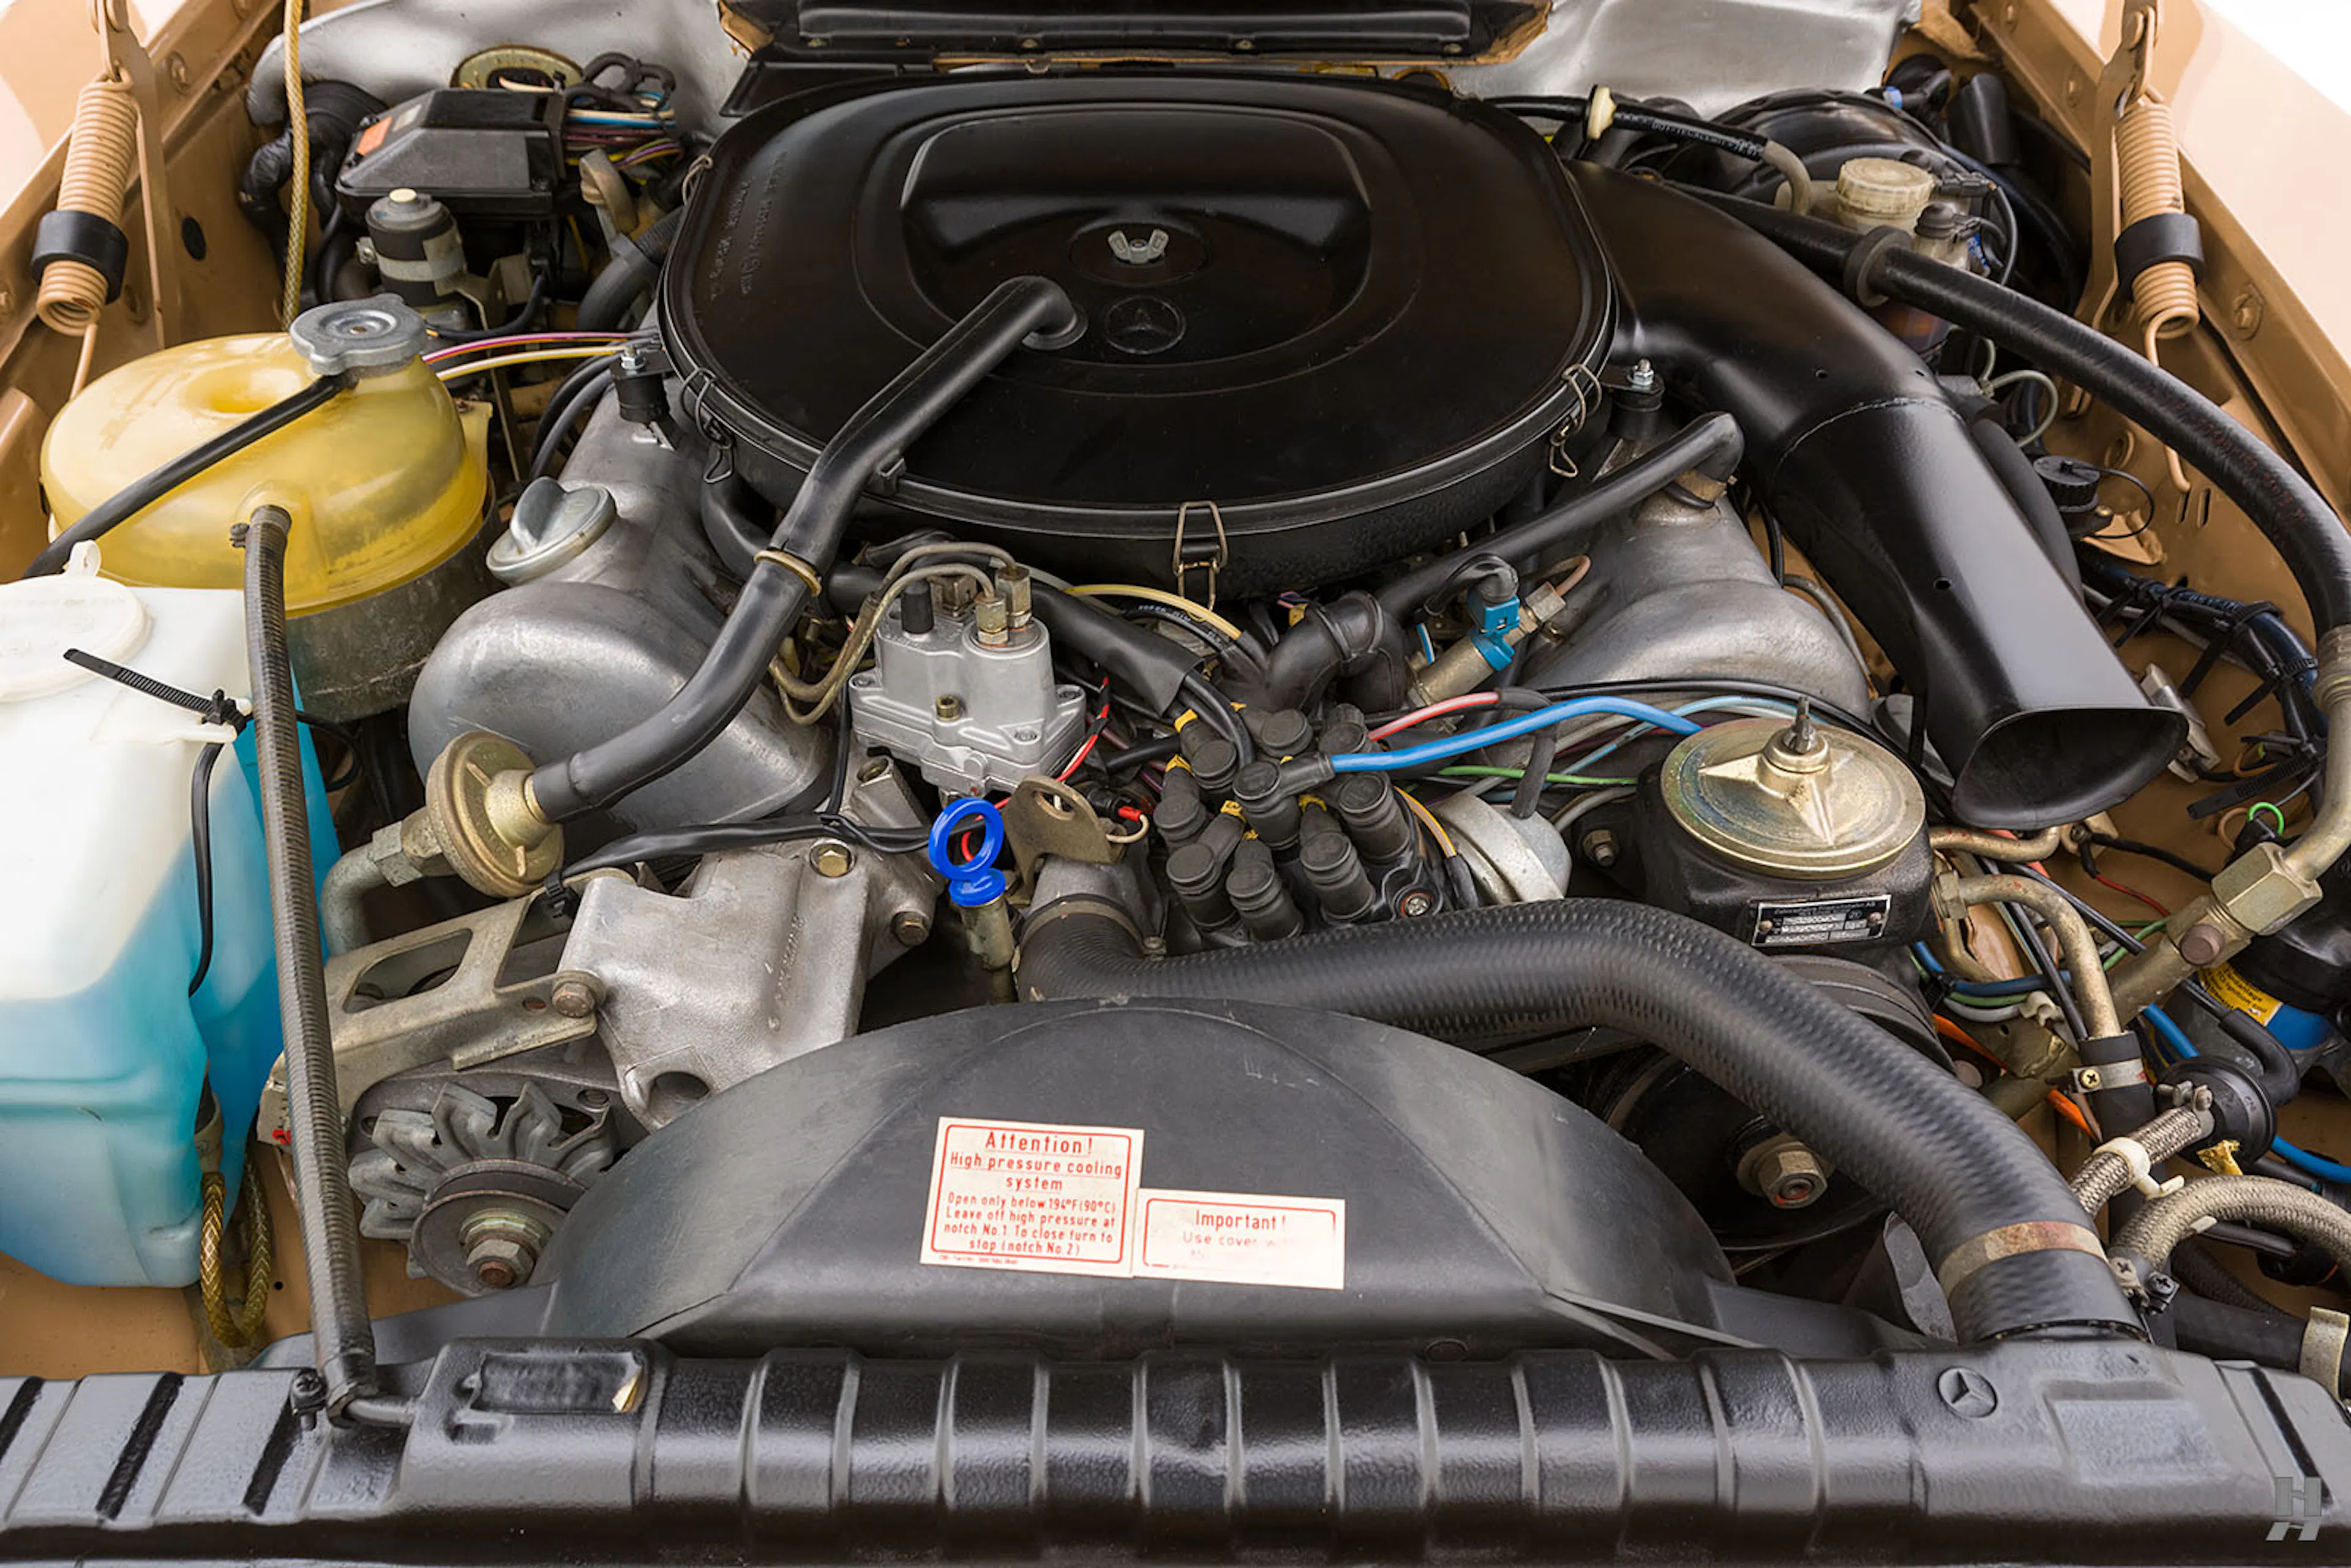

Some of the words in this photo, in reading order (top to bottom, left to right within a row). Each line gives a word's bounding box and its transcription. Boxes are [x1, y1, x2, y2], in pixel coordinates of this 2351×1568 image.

[986, 1131, 1092, 1153] Attention!
[951, 1152, 981, 1169] High
[988, 1157, 1060, 1172] pressure
[1068, 1161, 1122, 1179] cooling
[1007, 1176, 1062, 1191] system
[948, 1191, 976, 1205] Open
[982, 1196, 1005, 1208] only
[1011, 1198, 1044, 1208] below
[946, 1206, 980, 1220] Leave
[988, 1208, 1004, 1220] off
[1010, 1209, 1035, 1223] high
[1040, 1215, 1097, 1229] pressure
[1104, 1217, 1115, 1227] at
[943, 1223, 977, 1235] notch
[1015, 1225, 1027, 1238] To
[1032, 1228, 1064, 1240] close
[1070, 1229, 1096, 1241] turn
[1100, 1231, 1113, 1243] to
[1183, 1232, 1211, 1245] Use
[1219, 1236, 1257, 1247] cover
[970, 1239, 997, 1252] stop
